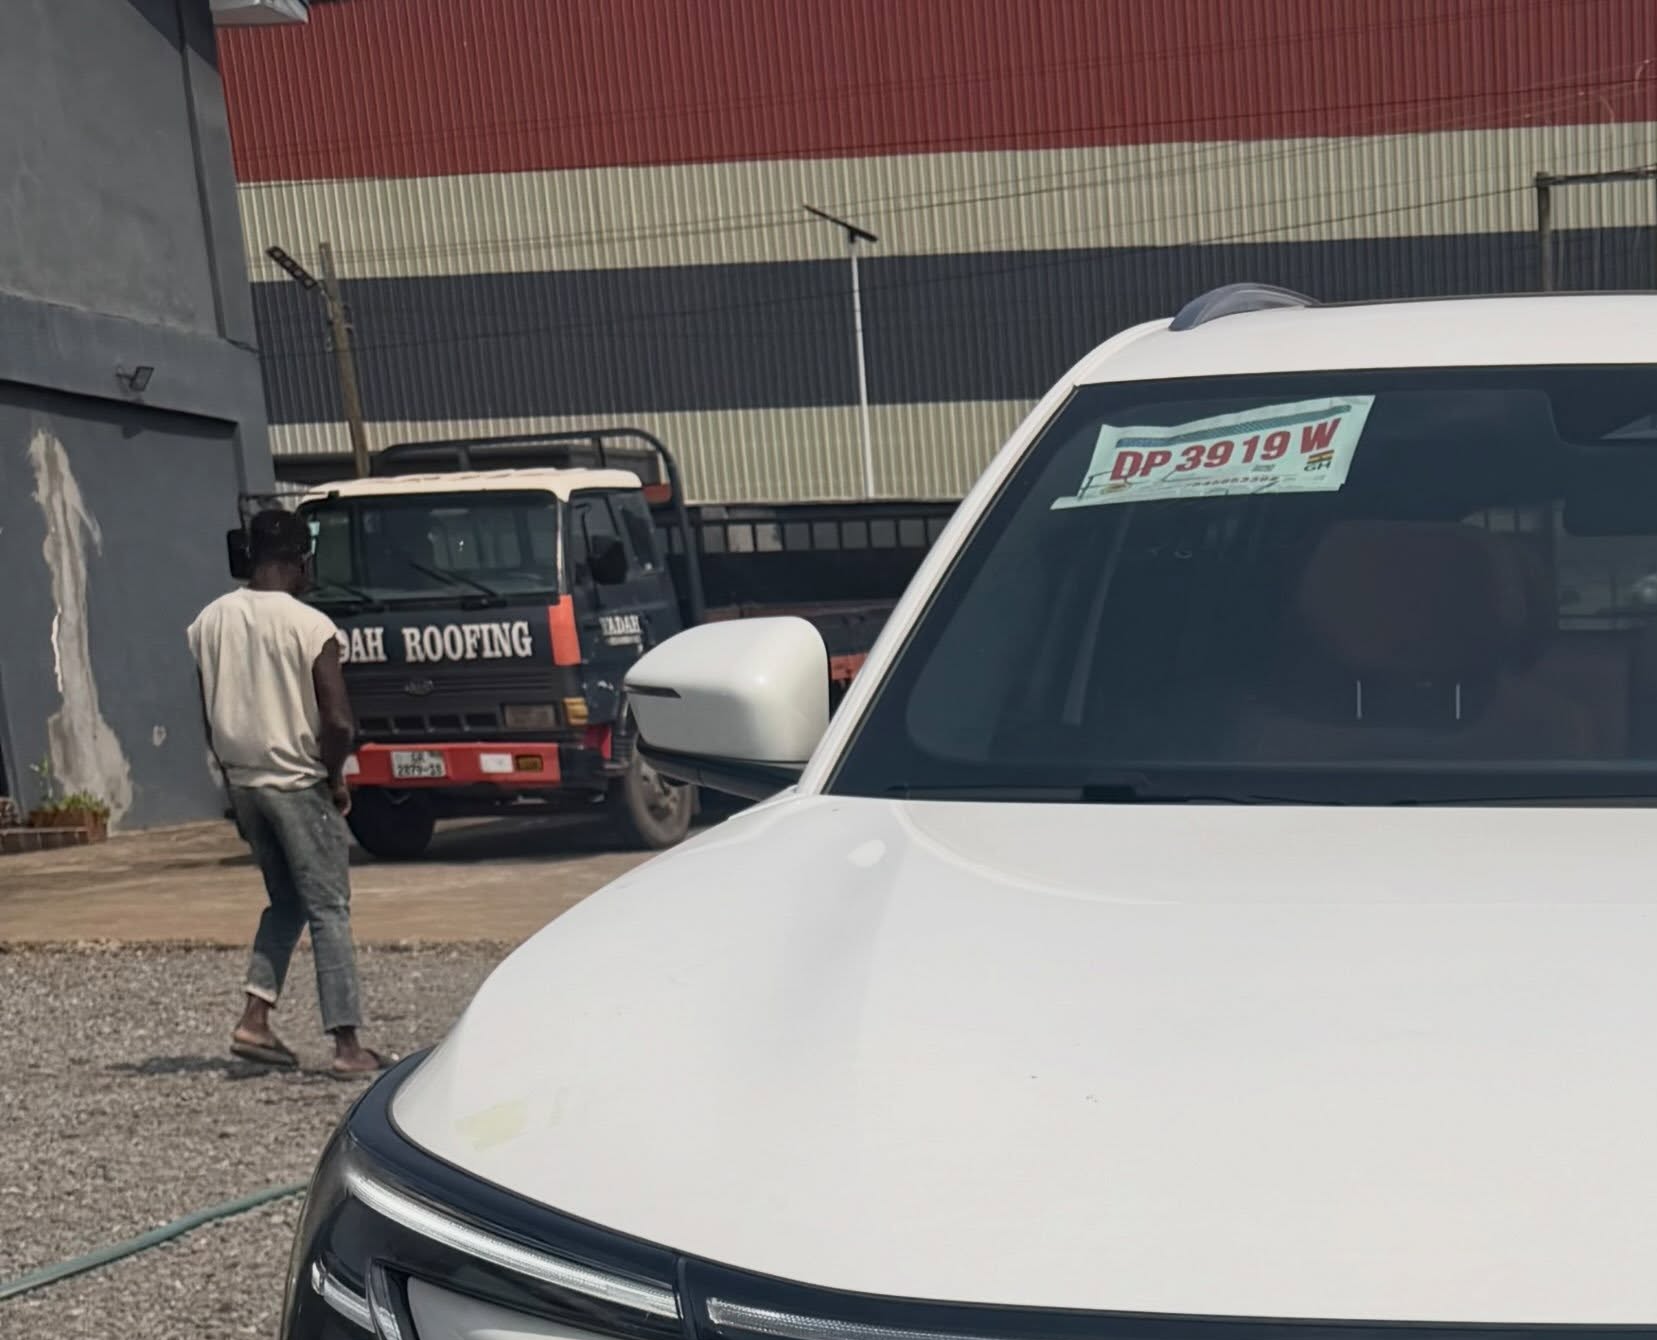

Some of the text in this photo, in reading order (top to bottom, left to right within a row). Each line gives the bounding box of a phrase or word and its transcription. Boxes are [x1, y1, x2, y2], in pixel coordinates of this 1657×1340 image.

[1109, 450, 1172, 481] DP
[1300, 417, 1342, 454] W
[1303, 459, 1332, 473] GH
[402, 621, 533, 663] ROOFING
